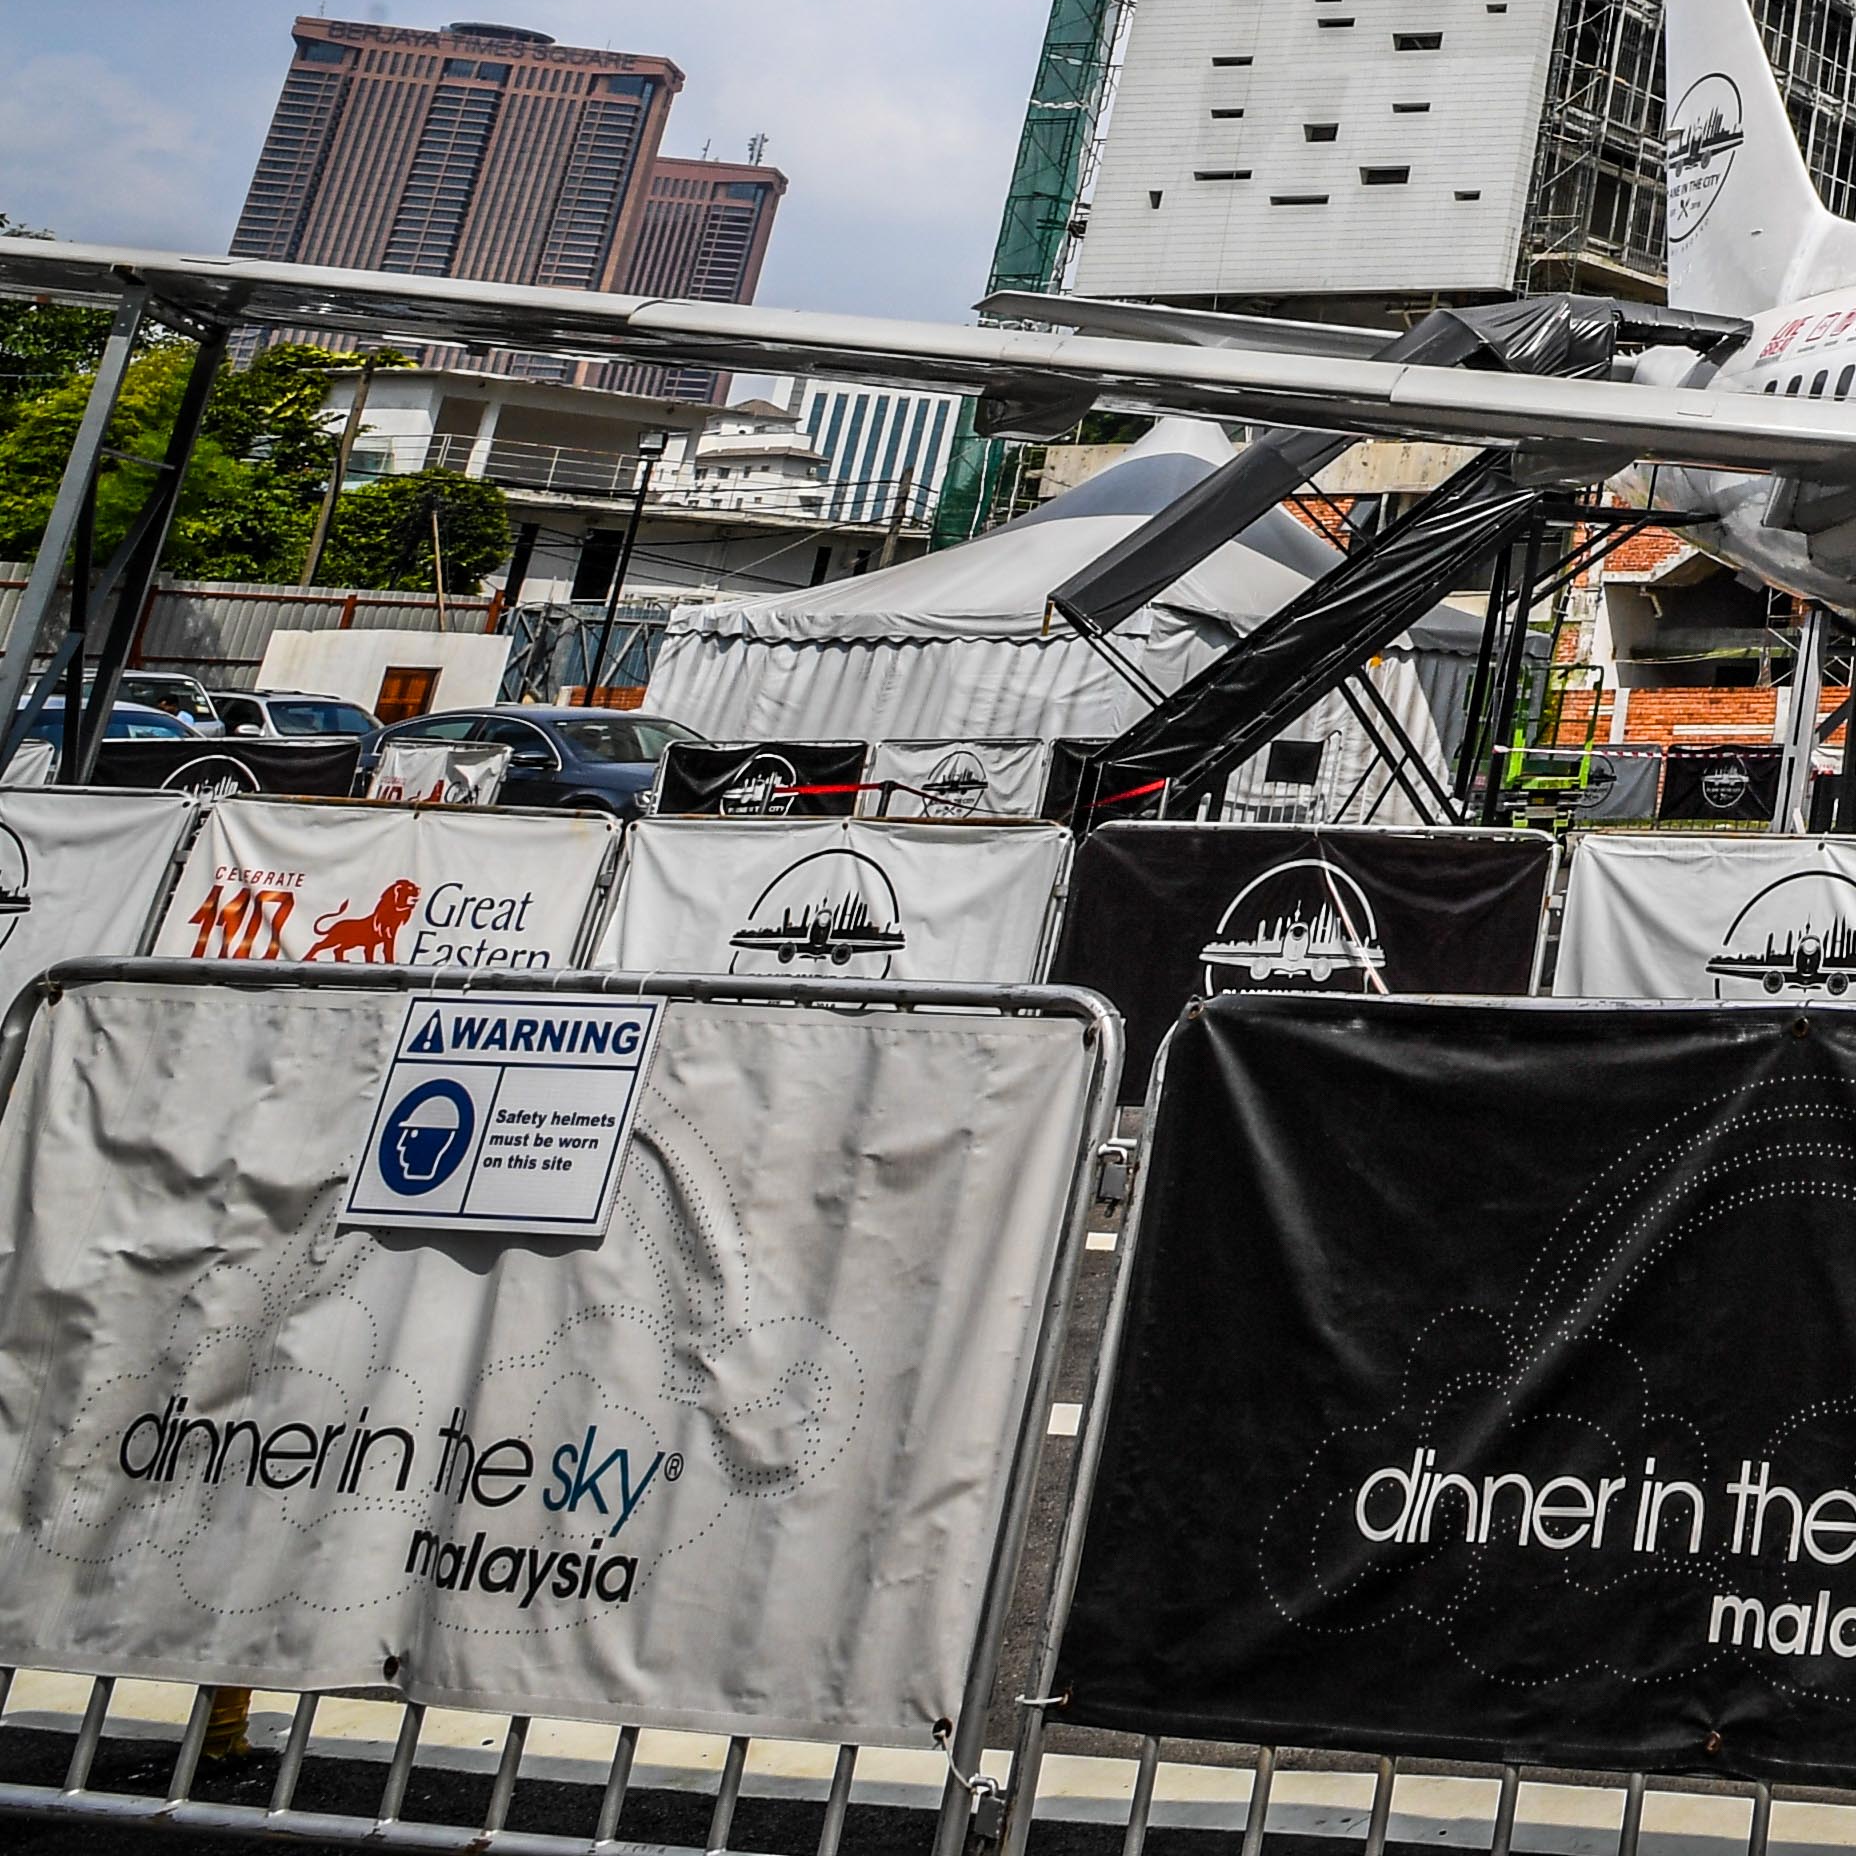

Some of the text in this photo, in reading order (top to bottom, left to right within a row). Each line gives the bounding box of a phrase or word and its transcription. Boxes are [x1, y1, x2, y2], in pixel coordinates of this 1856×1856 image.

[328, 21, 638, 70] BERJAYA TIMES SQUARE
[215, 866, 306, 887] CELEBRATE
[425, 882, 533, 932] Great
[451, 1017, 641, 1055] WARNING
[496, 1109, 616, 1128] Safety helmets
[489, 1133, 599, 1149] must be worn
[483, 1155, 572, 1171] on this site
[119, 1396, 346, 1489] dinner
[337, 1407, 416, 1494] in
[434, 1406, 533, 1507] the
[1354, 1447, 1625, 1550] dinner
[1634, 1457, 1706, 1553] in
[404, 1528, 638, 1608] malaysia
